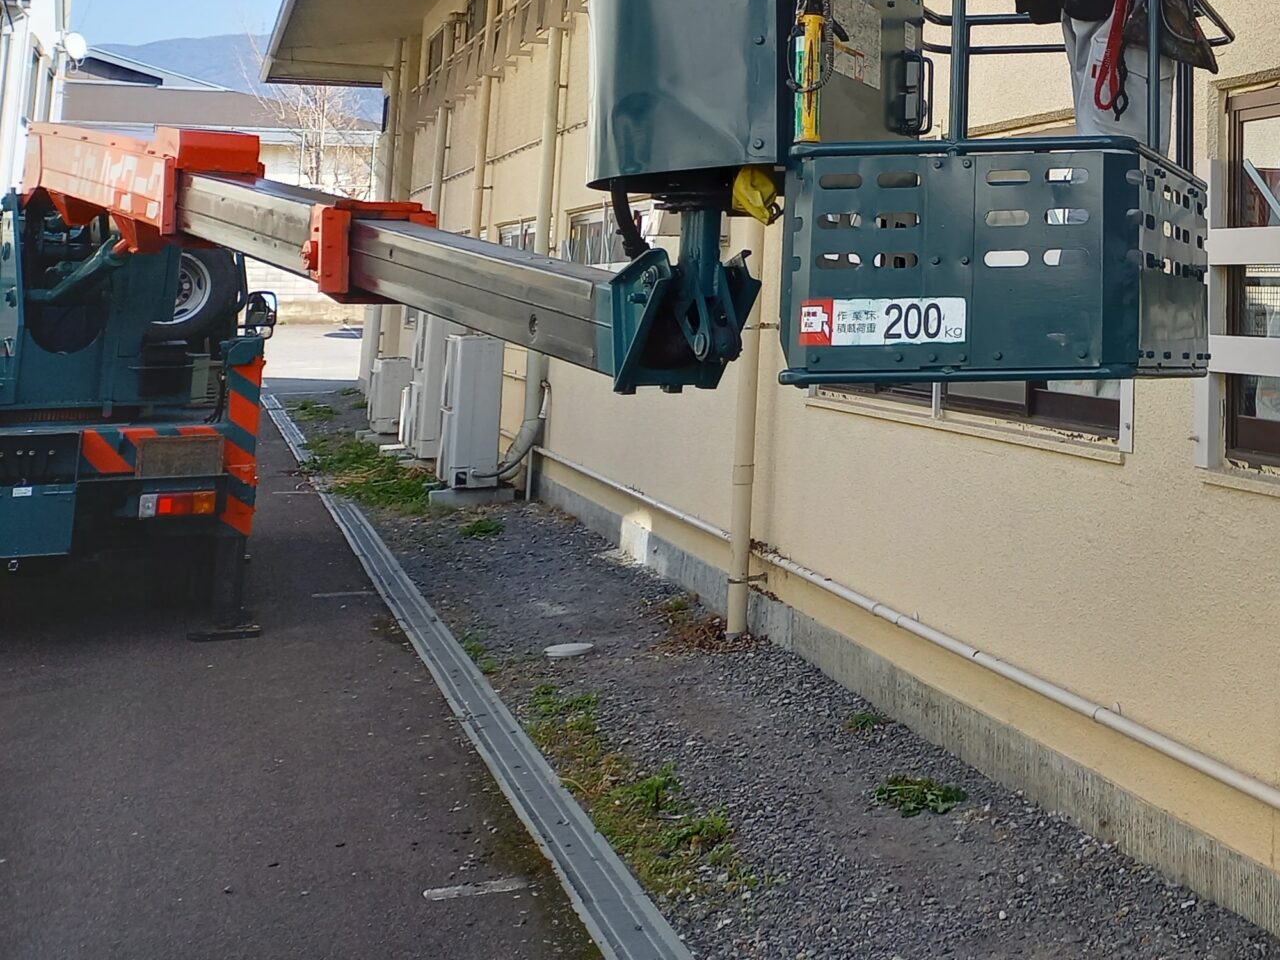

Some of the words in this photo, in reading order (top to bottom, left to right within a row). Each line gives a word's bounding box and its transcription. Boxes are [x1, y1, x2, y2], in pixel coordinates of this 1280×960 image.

[837, 310, 877, 321] 作業床
[884, 303, 942, 340] 200
[944, 326, 963, 339] kg
[837, 323, 876, 334] 積載荷重
